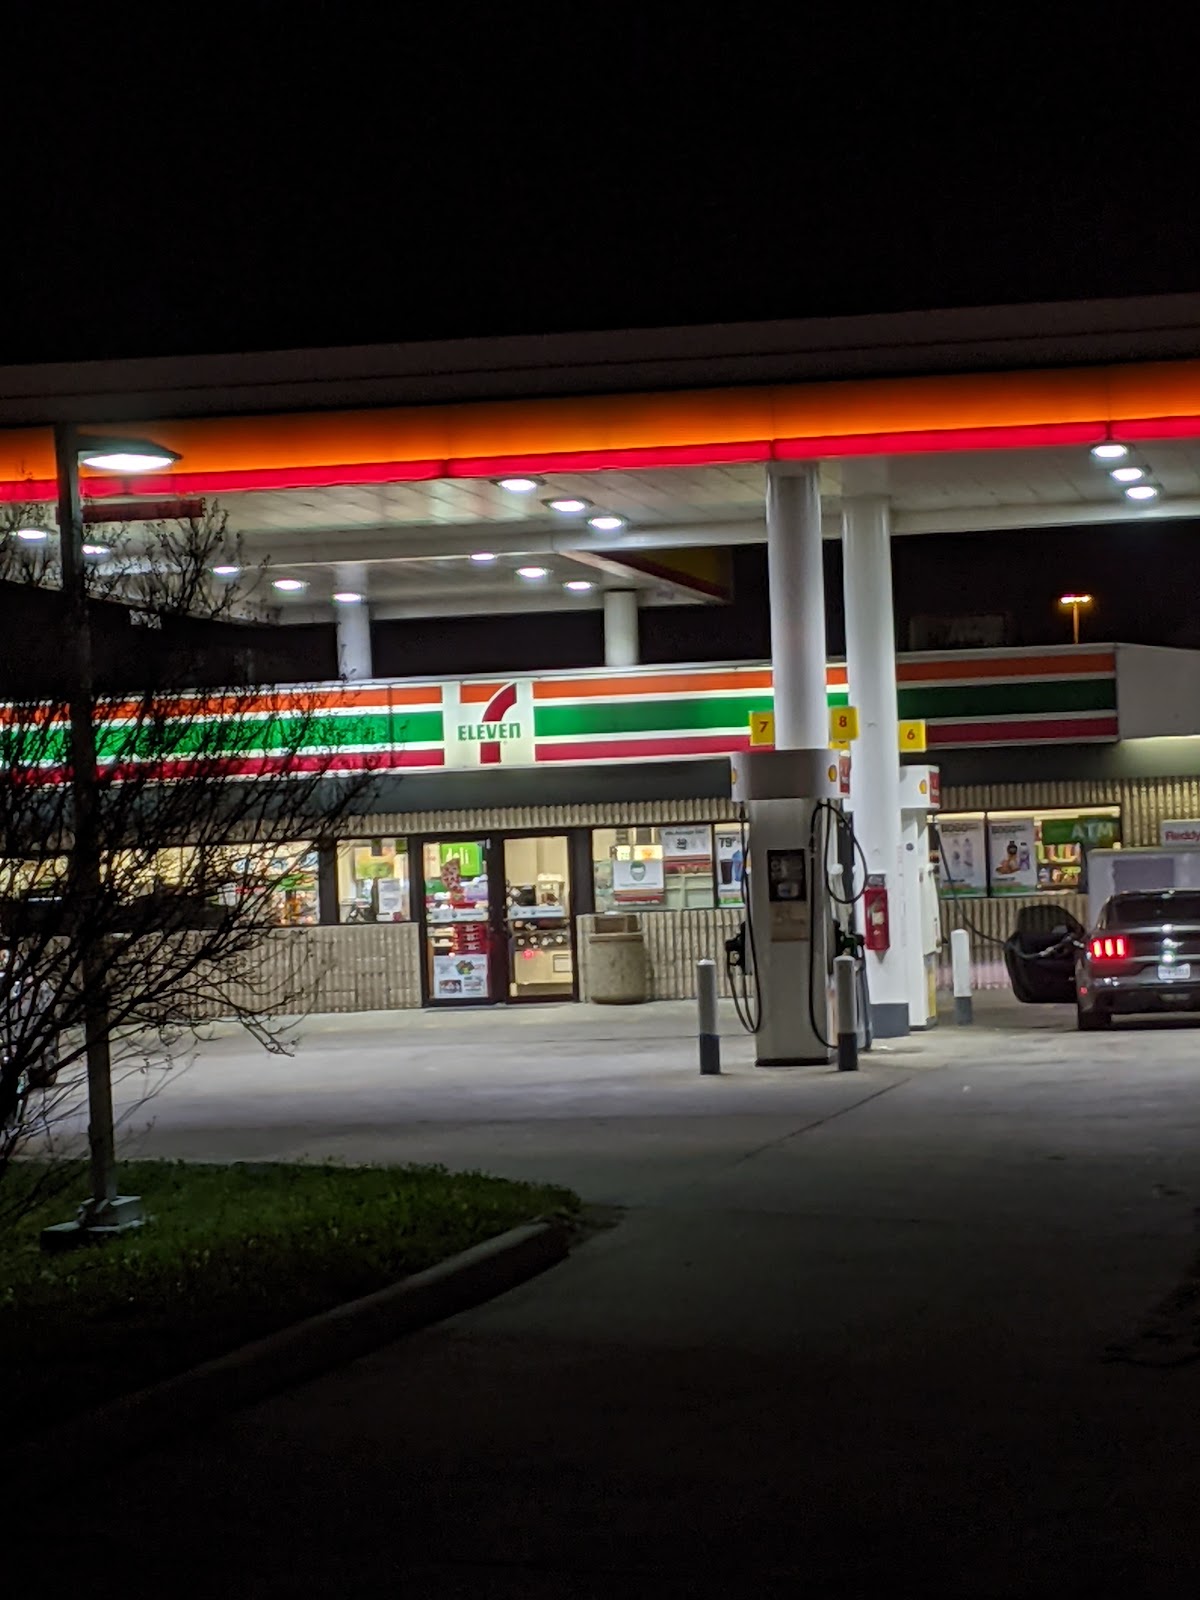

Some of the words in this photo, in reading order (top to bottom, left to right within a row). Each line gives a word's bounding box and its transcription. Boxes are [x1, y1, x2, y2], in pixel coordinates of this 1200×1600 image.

[759, 721, 769, 733] 7
[838, 715, 848, 728] 8
[906, 729, 916, 740] 6
[1071, 821, 1114, 839] ATM
